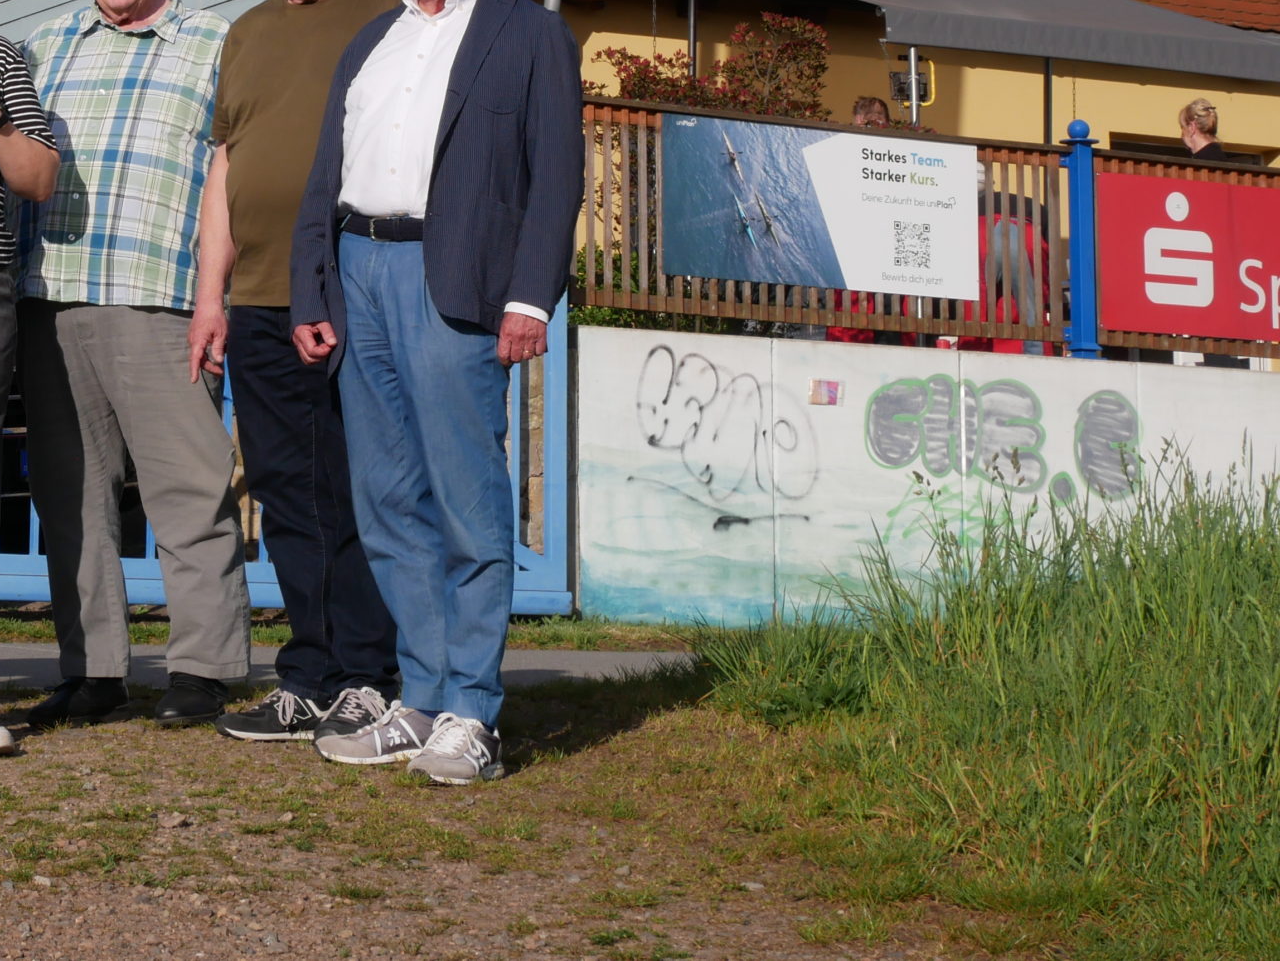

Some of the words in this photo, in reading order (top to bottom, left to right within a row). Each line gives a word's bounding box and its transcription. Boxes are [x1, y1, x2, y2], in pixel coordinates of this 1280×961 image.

[862, 148, 907, 165] Starkes
[910, 152, 947, 168] Team.
[862, 167, 906, 183] Starker
[909, 172, 939, 187] Kurs.
[862, 192, 883, 203] Deine
[884, 194, 912, 206] Zukunft
[914, 198, 926, 207] bei
[926, 199, 953, 210] uniPlan
